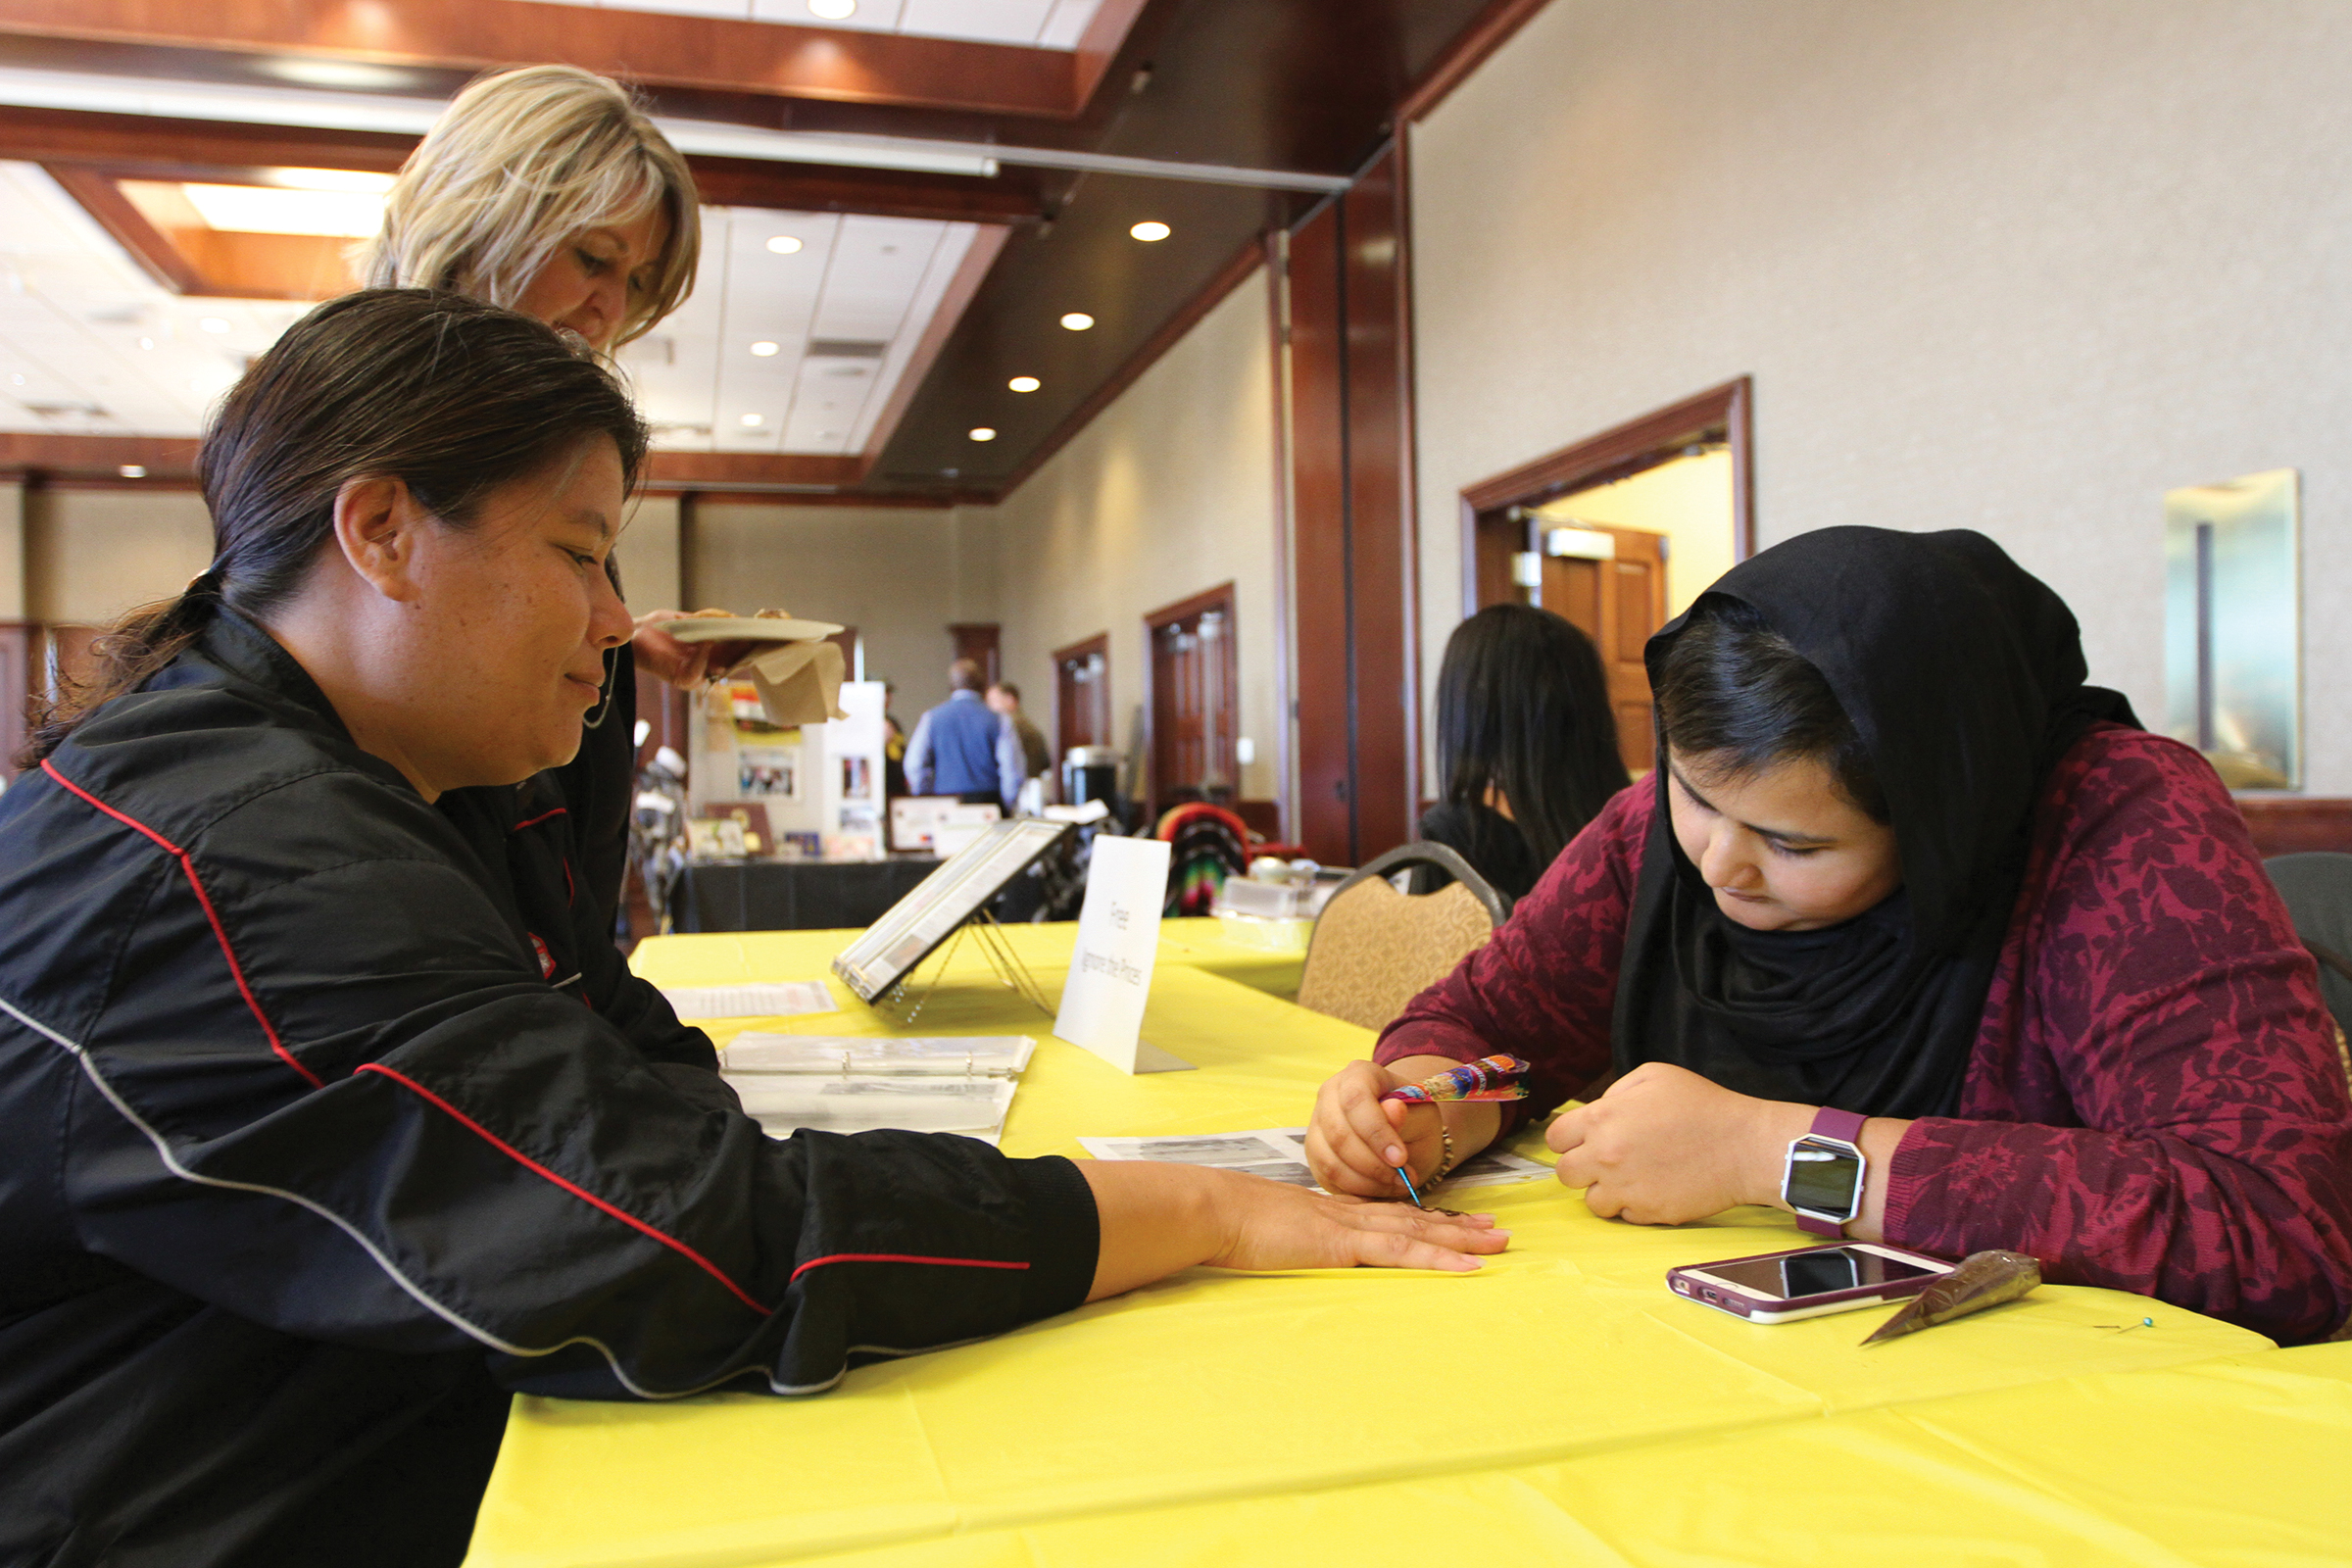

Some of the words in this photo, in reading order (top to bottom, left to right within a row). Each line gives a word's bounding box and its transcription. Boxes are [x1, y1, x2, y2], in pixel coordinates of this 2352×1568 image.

[1109, 901, 1129, 930] Free
[1105, 954, 1119, 977] the
[1119, 957, 1142, 986] Prices
